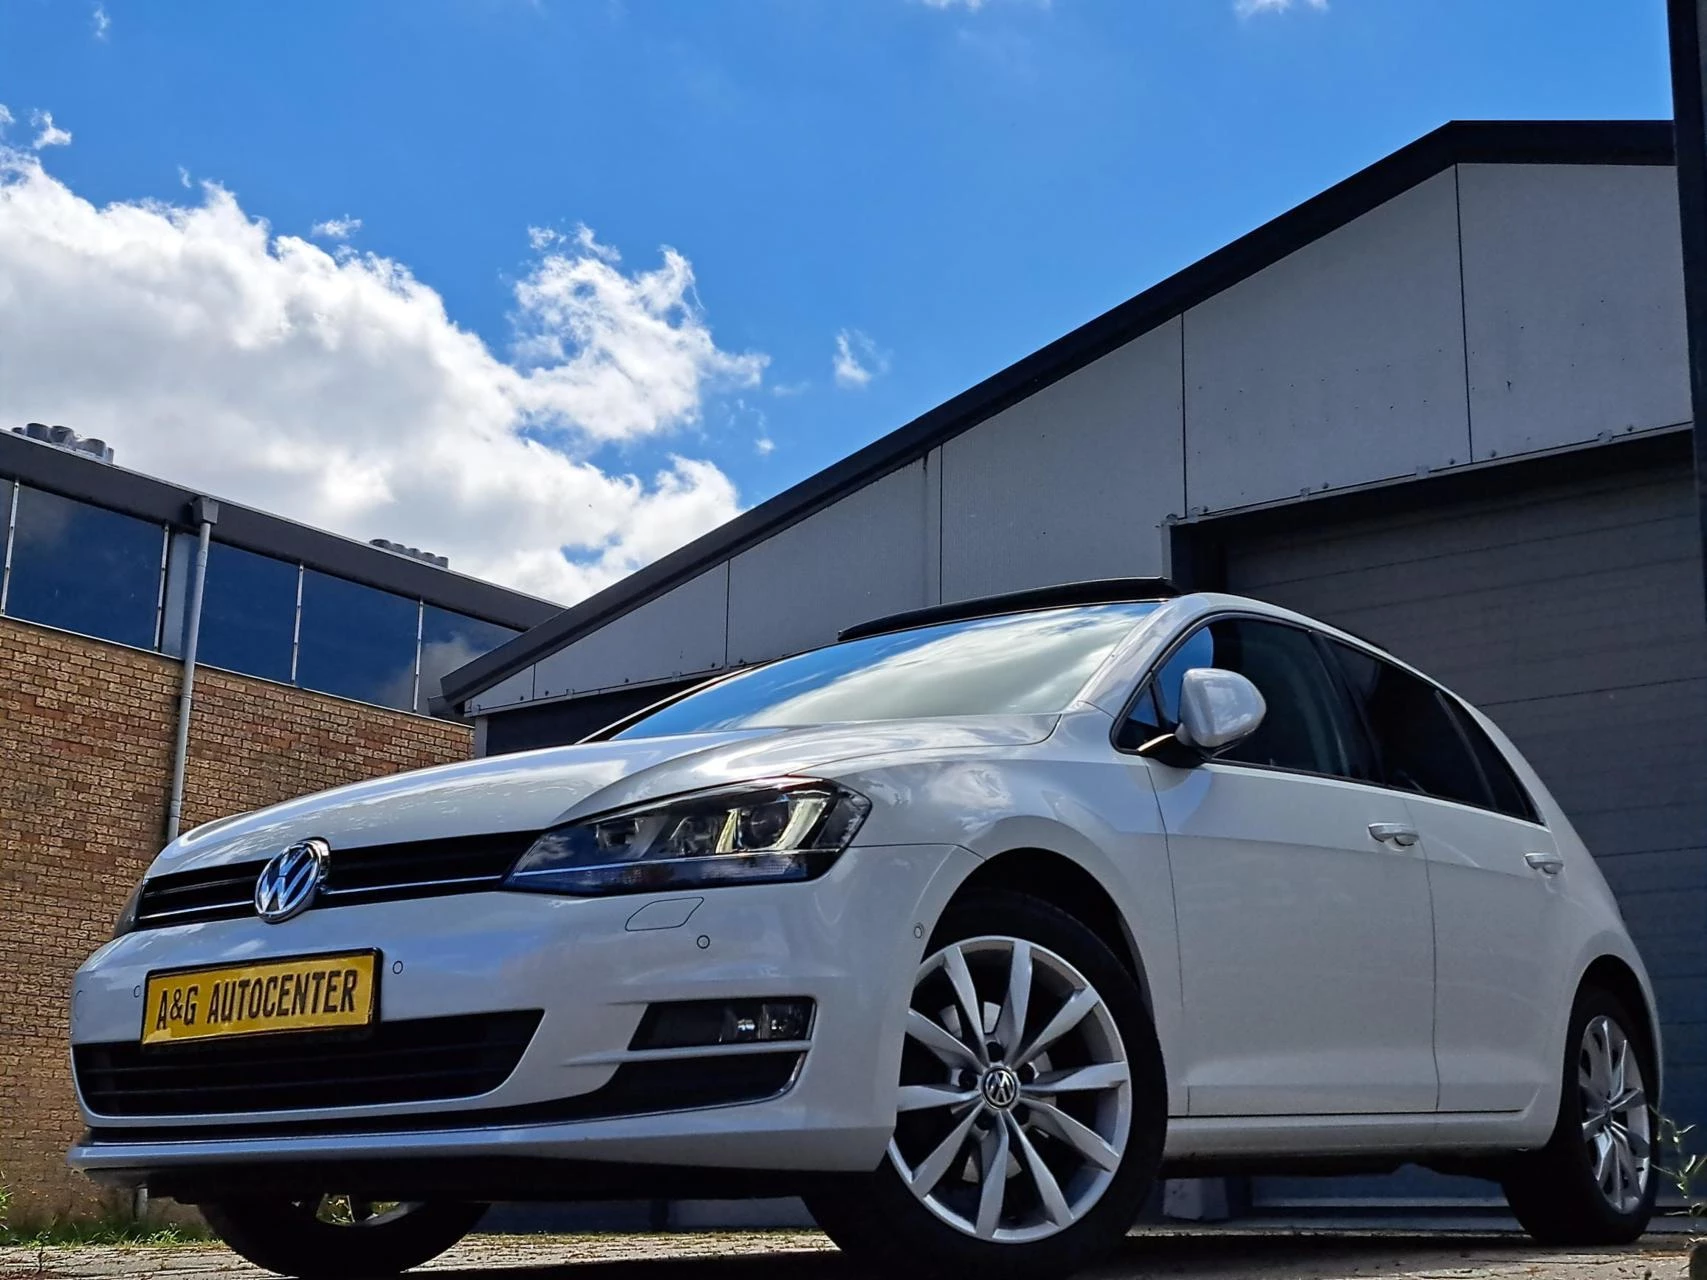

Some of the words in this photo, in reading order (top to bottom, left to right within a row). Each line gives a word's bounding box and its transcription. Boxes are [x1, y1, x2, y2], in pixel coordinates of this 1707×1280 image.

[256, 841, 320, 916] VW
[156, 985, 198, 1030] A&G
[207, 969, 358, 1024] AUTOCENTER
[984, 1069, 1016, 1106] VW
